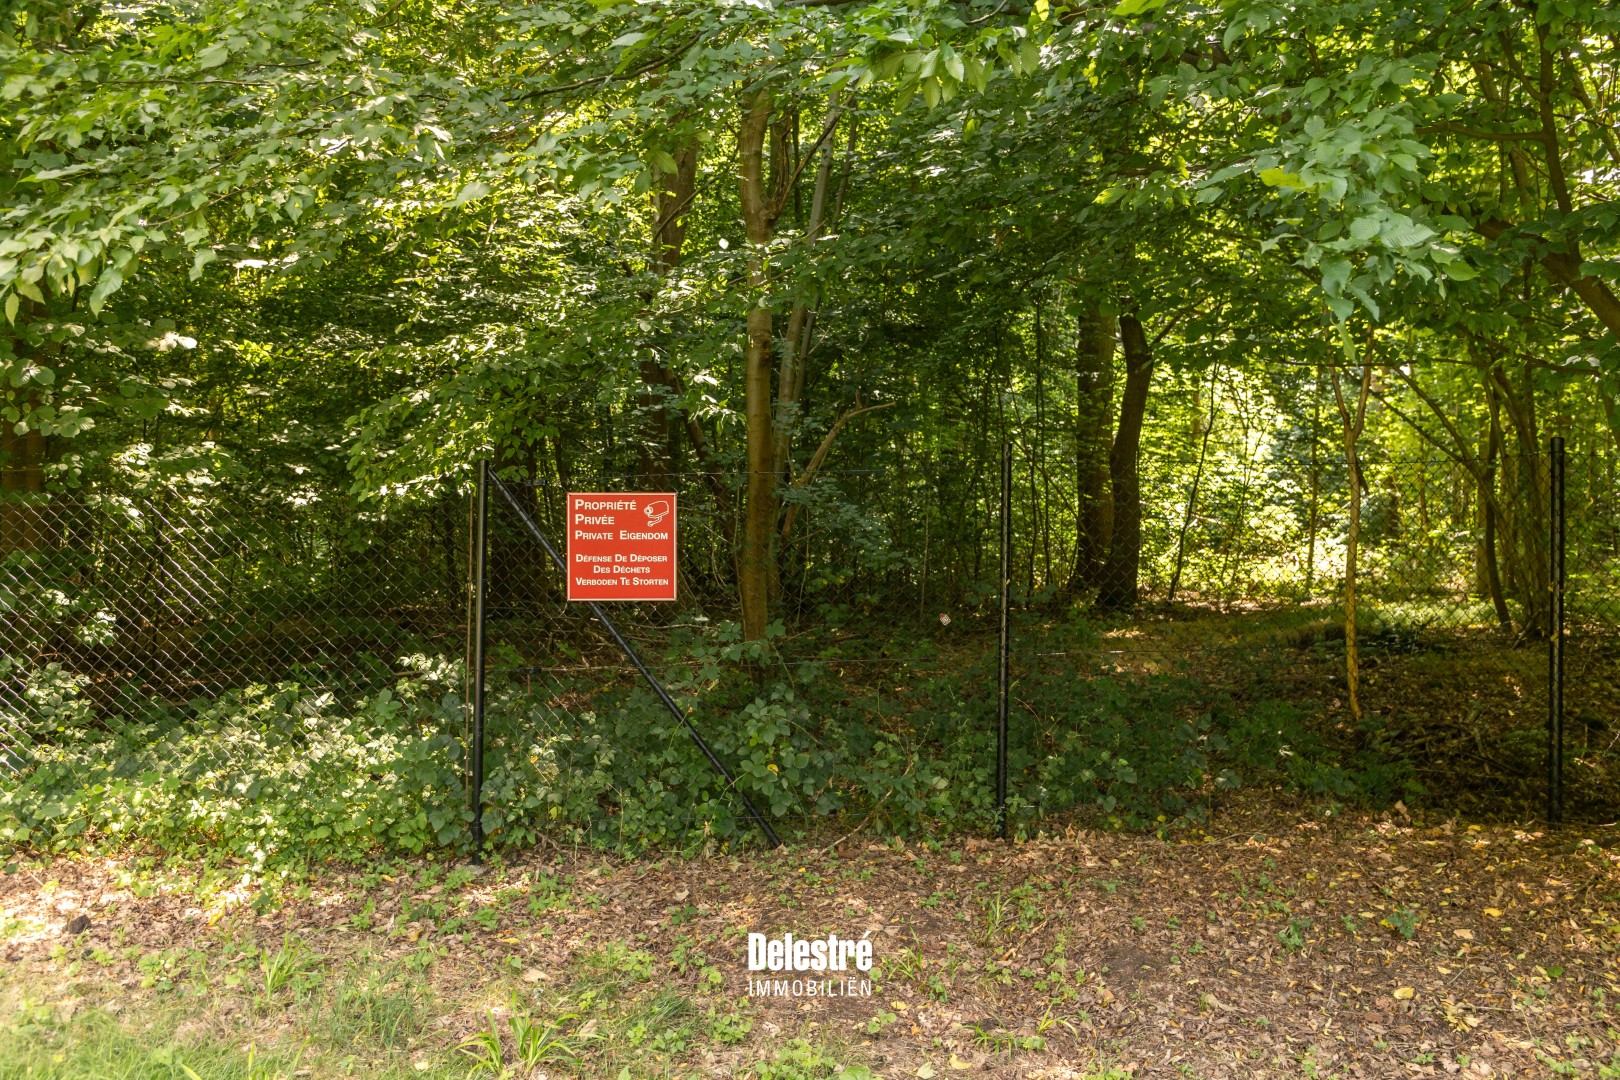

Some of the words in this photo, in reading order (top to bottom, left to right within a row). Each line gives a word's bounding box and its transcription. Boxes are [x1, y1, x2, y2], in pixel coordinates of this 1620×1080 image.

[575, 499, 637, 510] PROPRIÉTÉ
[575, 514, 615, 525] PRIVÉE
[575, 530, 613, 540] PRIVATE
[620, 530, 668, 540] EIGENDOM
[615, 554, 627, 562] DE
[630, 554, 668, 562] DÉPOSER
[593, 565, 611, 573] DES
[613, 565, 651, 574] DÉCHETS
[575, 577, 617, 586] VERBODEN
[620, 577, 630, 586] TE
[632, 577, 669, 586] STORTEN
